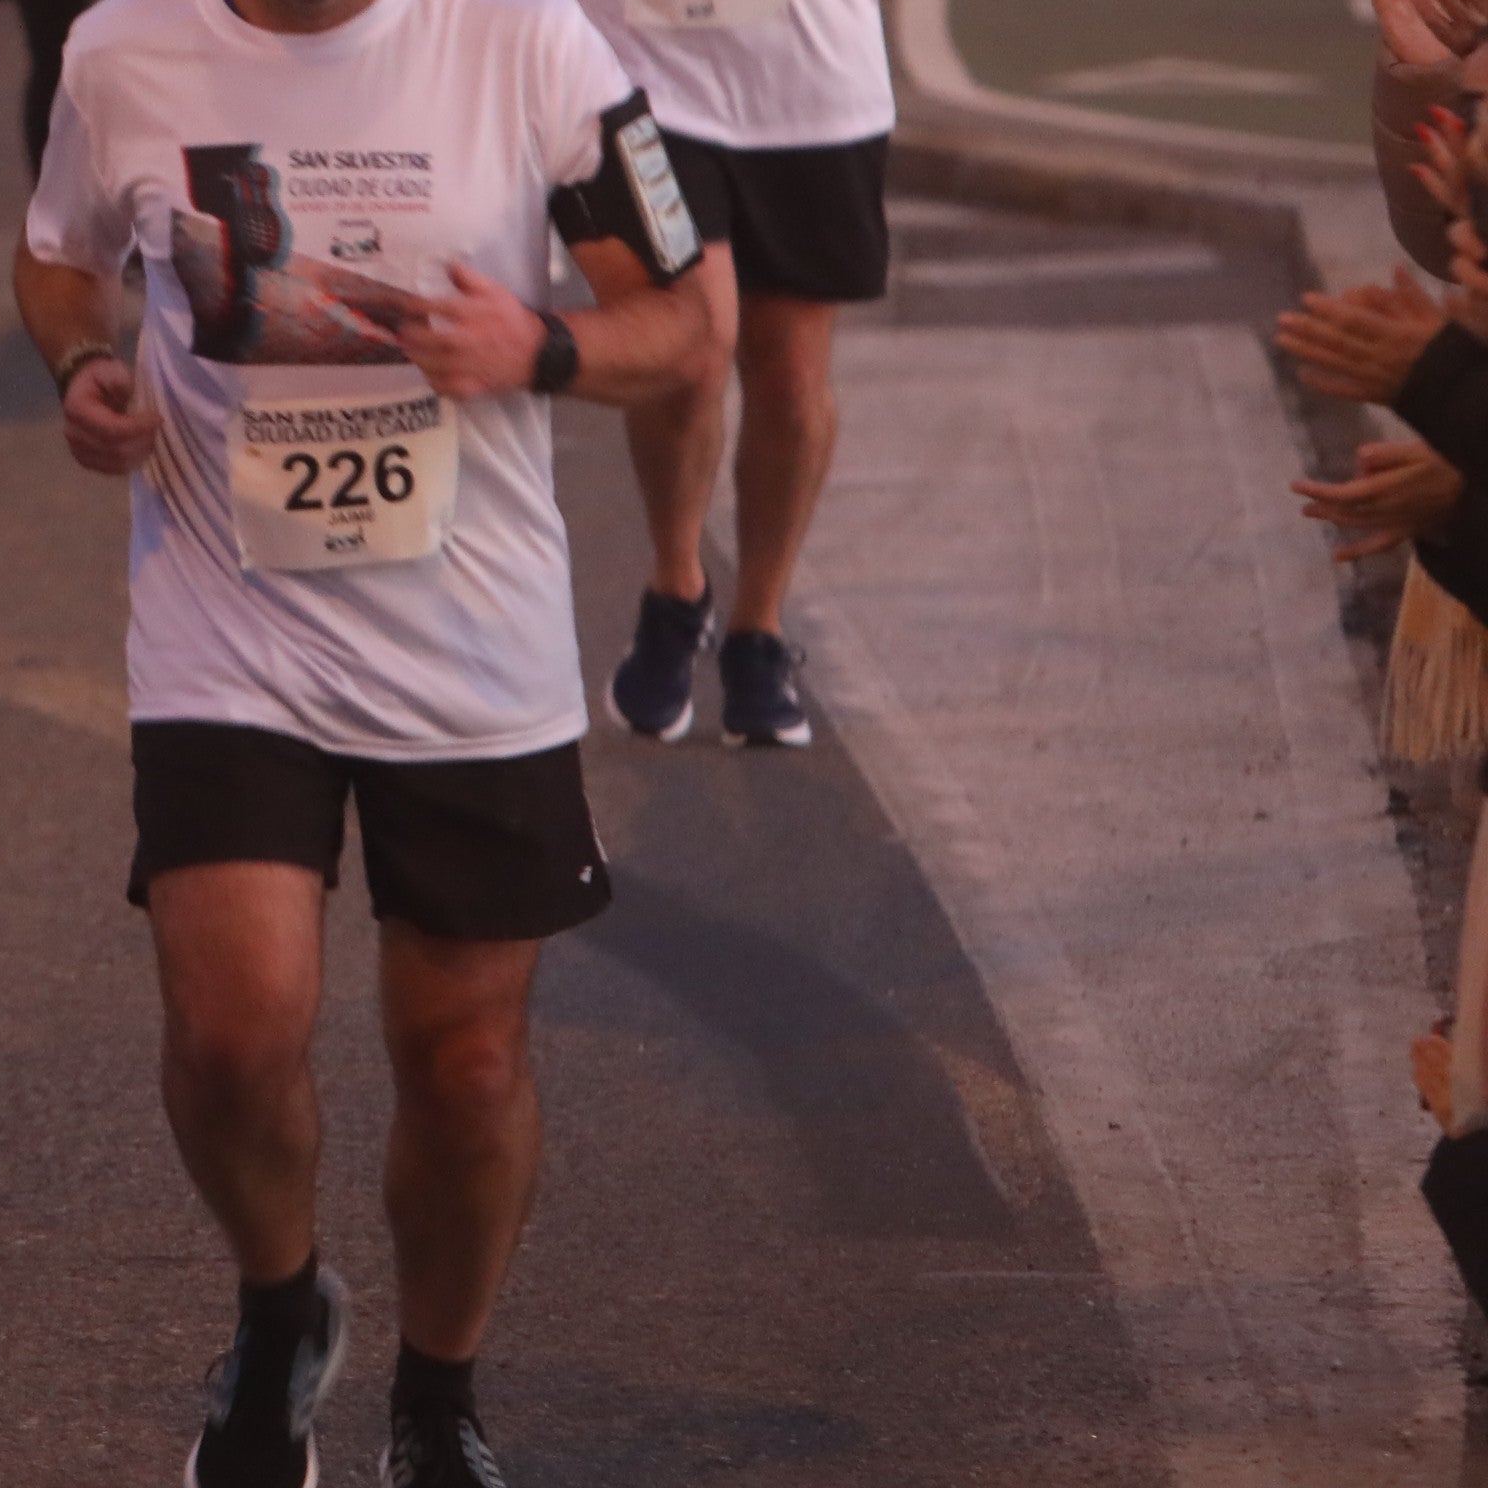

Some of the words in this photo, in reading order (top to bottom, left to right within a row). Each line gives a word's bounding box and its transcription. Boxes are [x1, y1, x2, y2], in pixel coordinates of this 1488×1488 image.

[289, 150, 329, 169] SAN
[334, 151, 433, 171] SILVESTRE
[244, 410, 293, 425] SAN
[282, 444, 415, 511] 226
